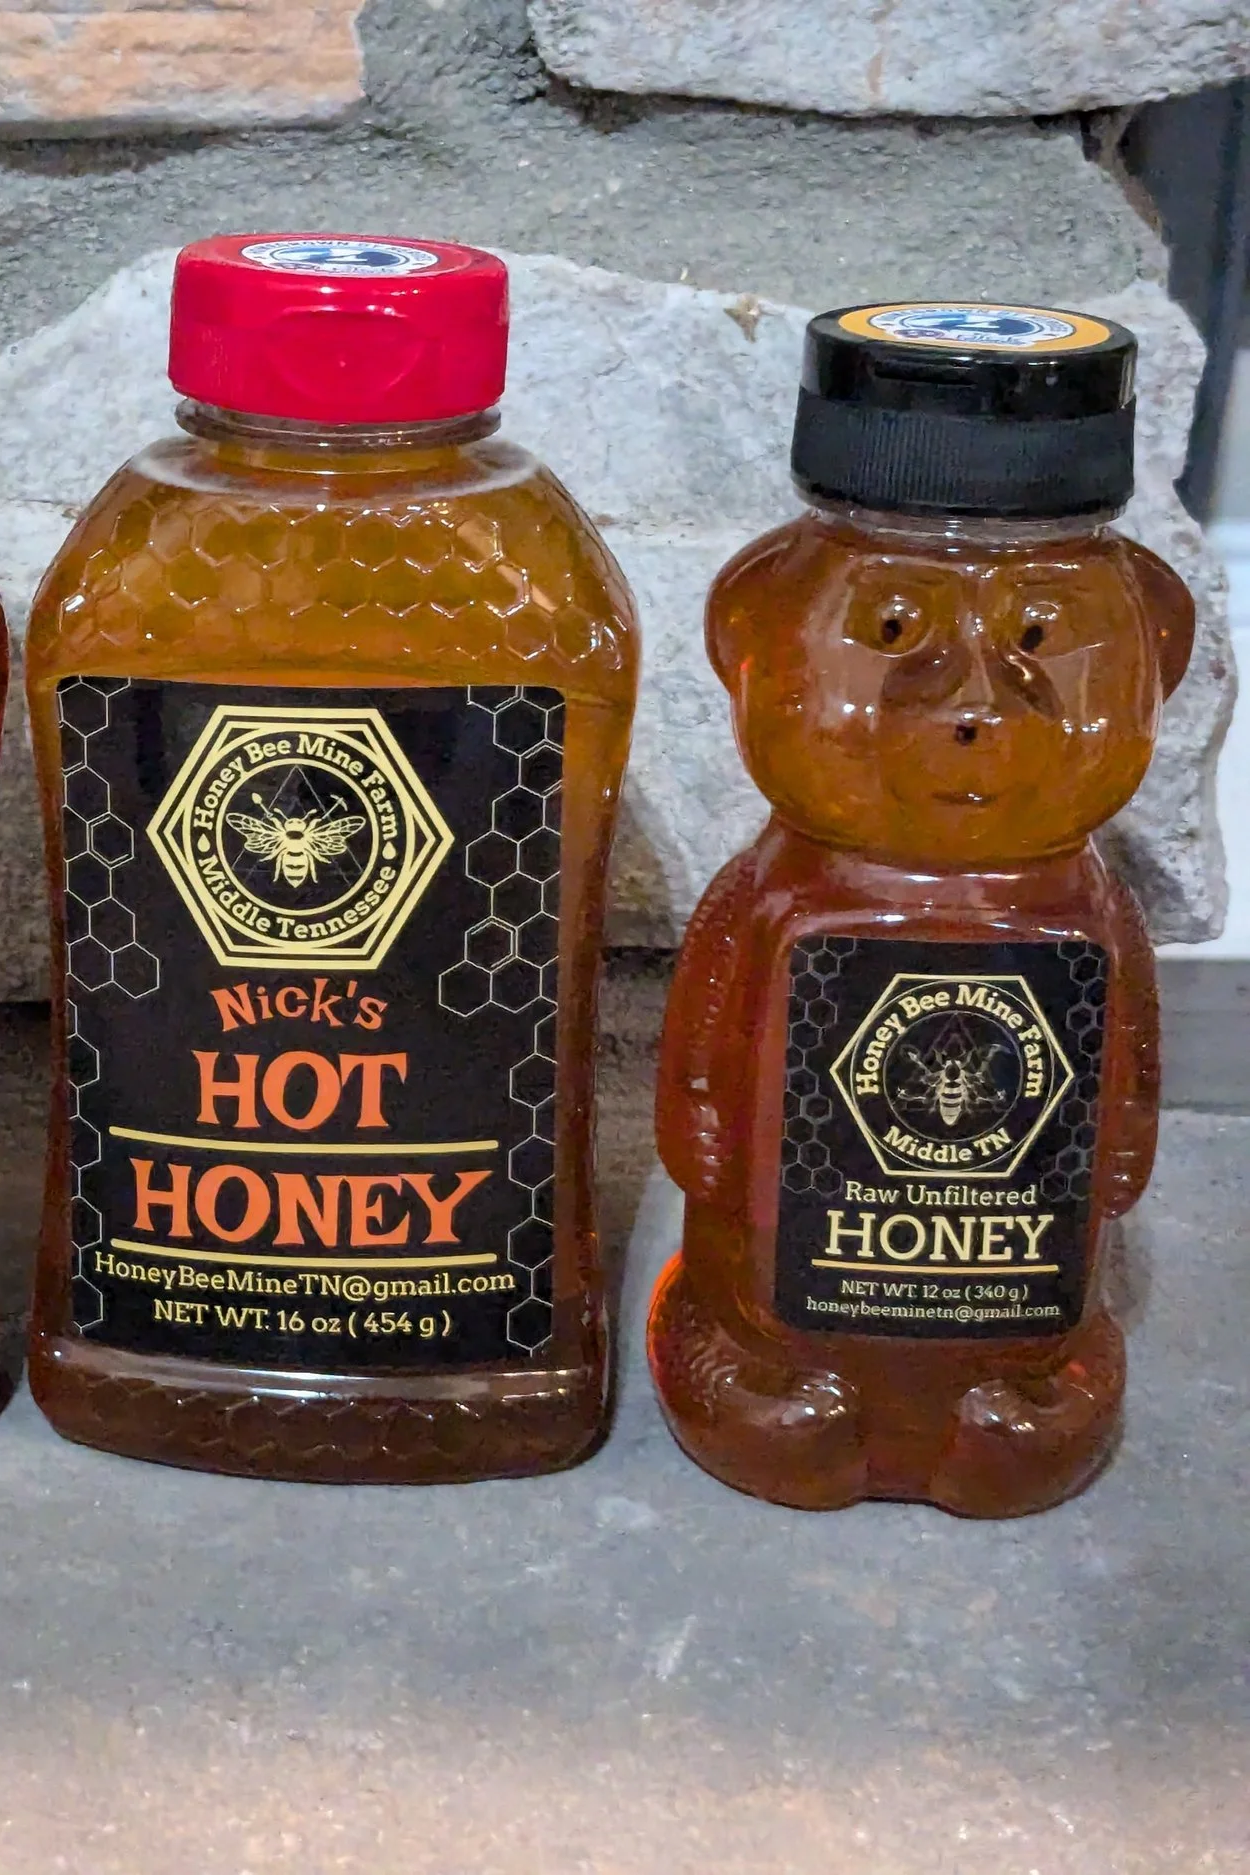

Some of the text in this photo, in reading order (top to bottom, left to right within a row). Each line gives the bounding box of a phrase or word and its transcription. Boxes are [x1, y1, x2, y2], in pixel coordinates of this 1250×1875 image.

[193, 733, 399, 841] Honey Bee Mine Farm
[198, 854, 397, 939] Middle Tennessee
[209, 977, 388, 1032] Nick's
[855, 984, 1046, 1098] Honey Bee Mine Farm
[191, 1049, 407, 1131] HOT
[882, 1125, 1012, 1163] Middle TN
[128, 1157, 494, 1247] HONEY
[845, 1180, 1038, 1206] Raw Unfiltered
[824, 1209, 1055, 1262] HONEY
[94, 1251, 517, 1302] HoneyBeeMineTN@gmail.com
[841, 1279, 880, 1296] NET
[922, 1284, 939, 1298] 12
[942, 1287, 961, 1299] oz
[154, 1298, 208, 1326] NET
[214, 1305, 270, 1331] WT.
[277, 1310, 305, 1332] 16
[311, 1317, 341, 1333] oz
[806, 1296, 1061, 1323] honeybeeminetn@gmail.com
